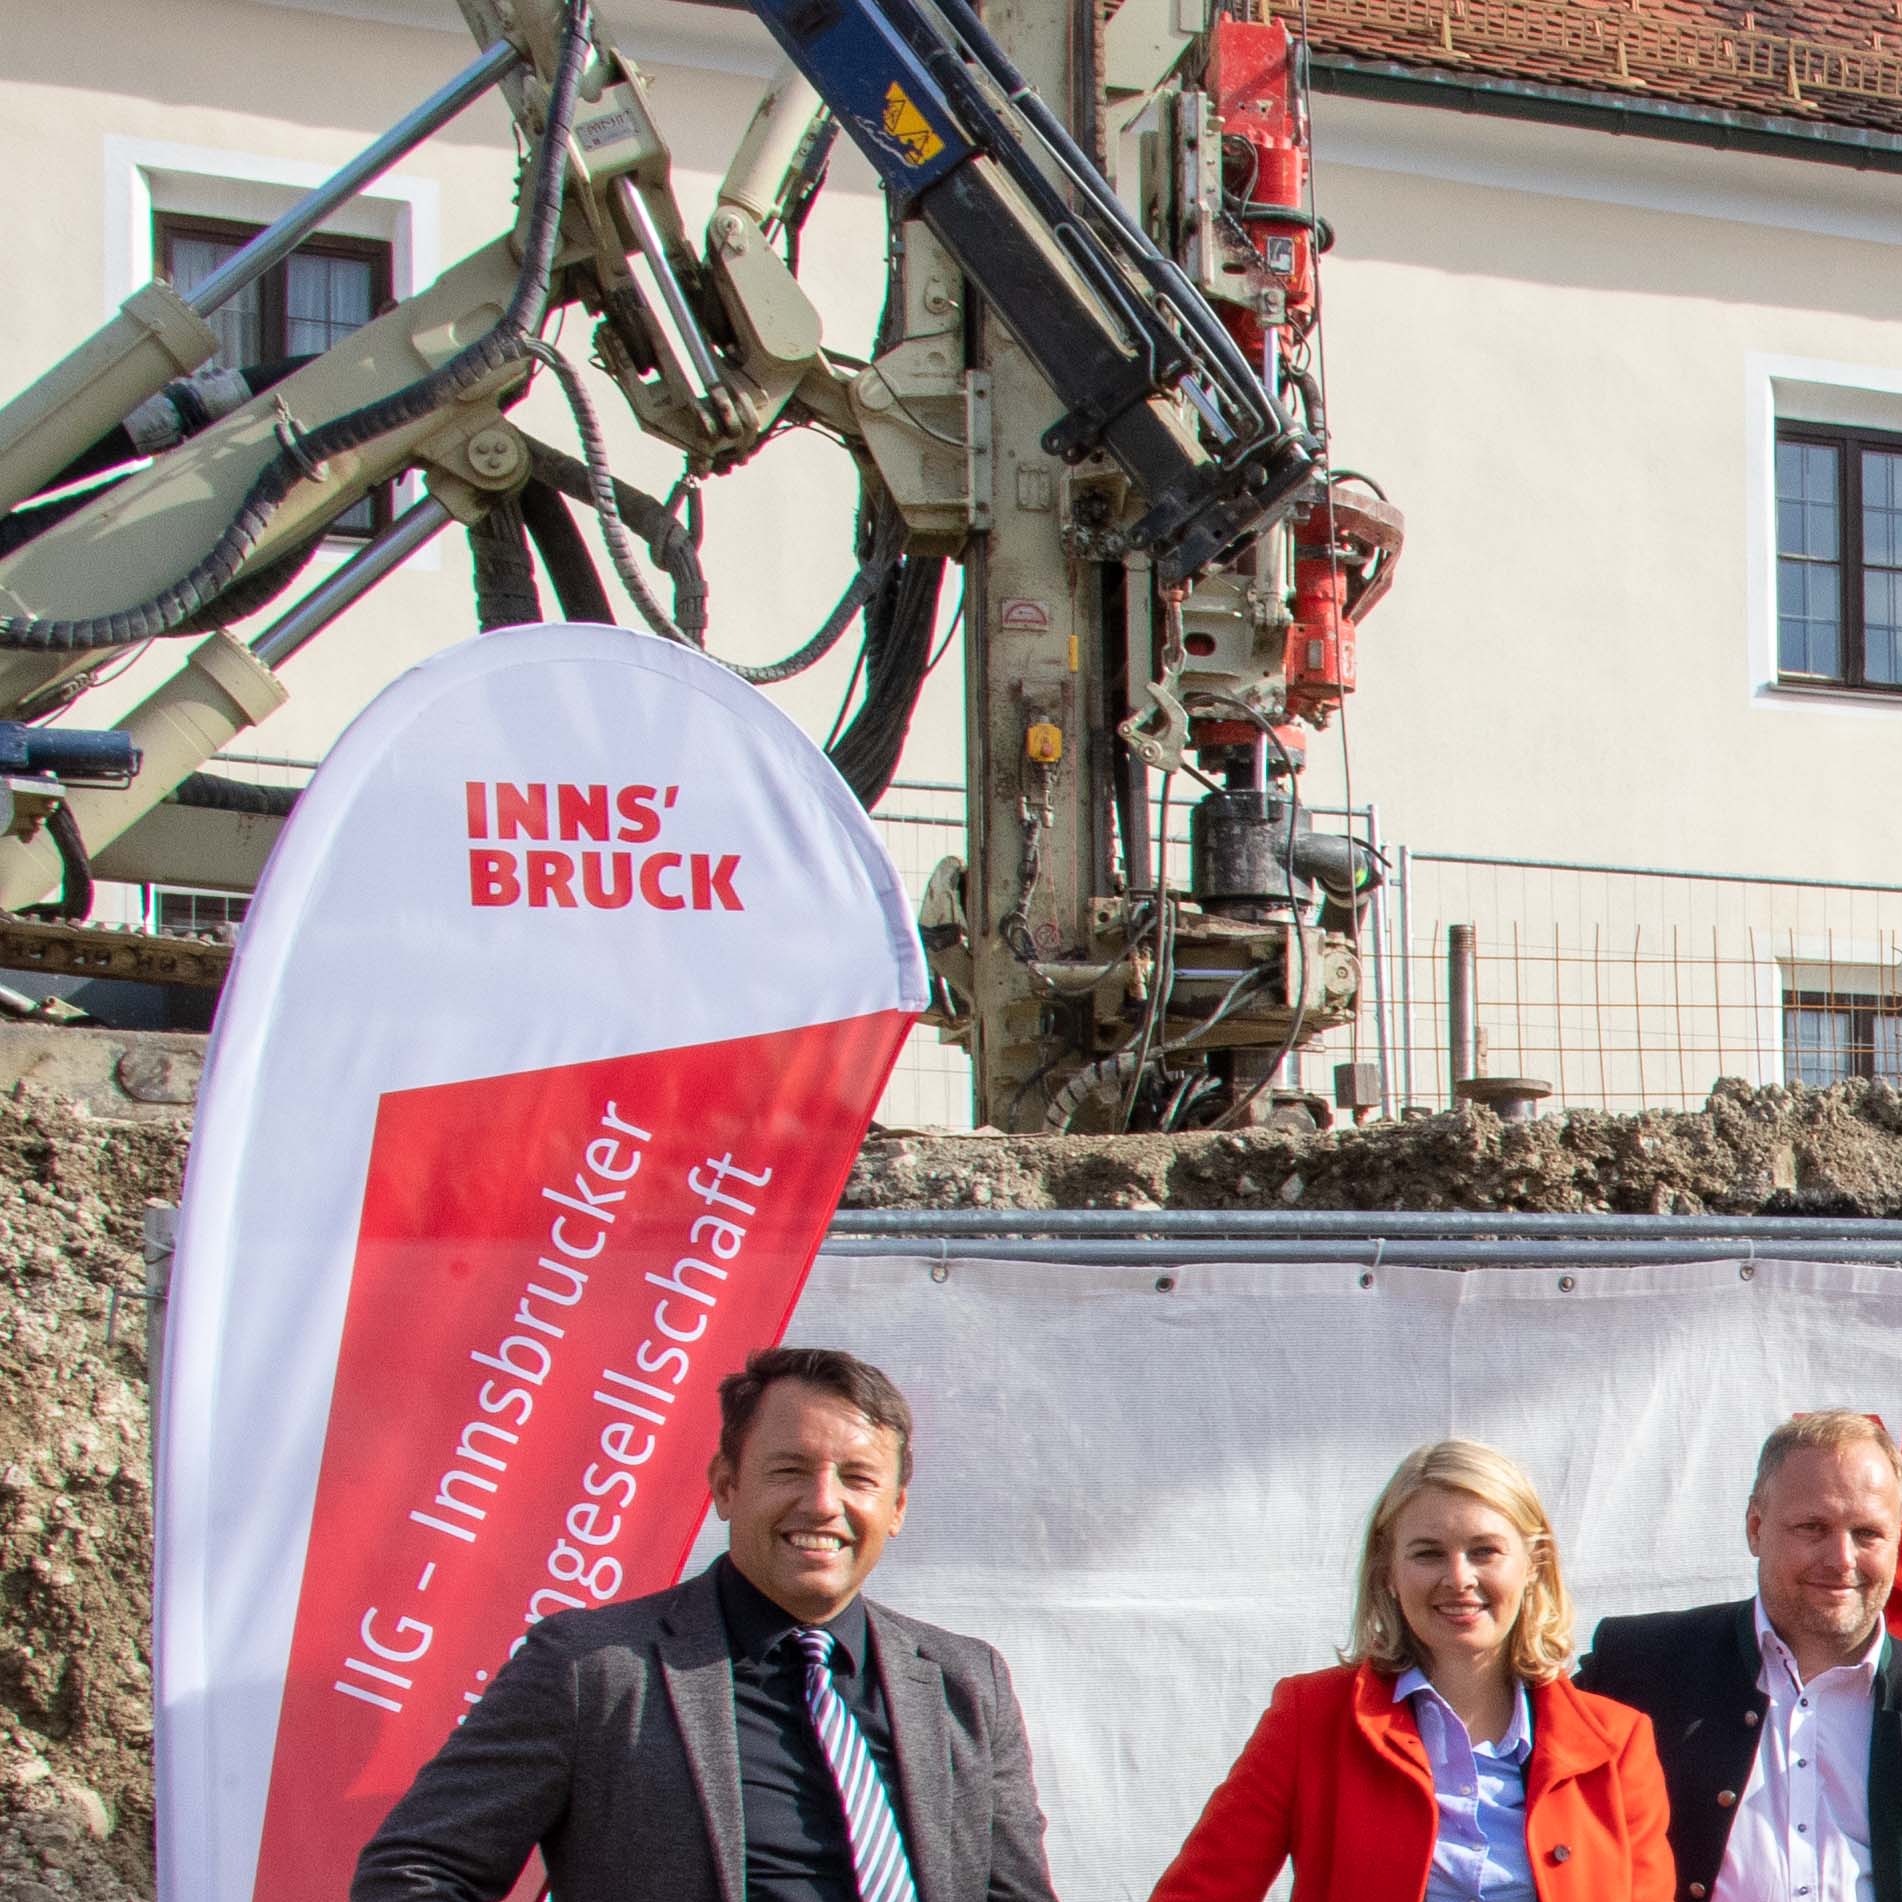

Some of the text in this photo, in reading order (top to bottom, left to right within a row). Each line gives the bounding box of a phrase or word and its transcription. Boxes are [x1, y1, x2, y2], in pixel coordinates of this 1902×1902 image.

[469, 848, 745, 912] BRUCK
[410, 1100, 653, 1543] Innsbrucker
[497, 1152, 773, 1665] ngesellschaft
